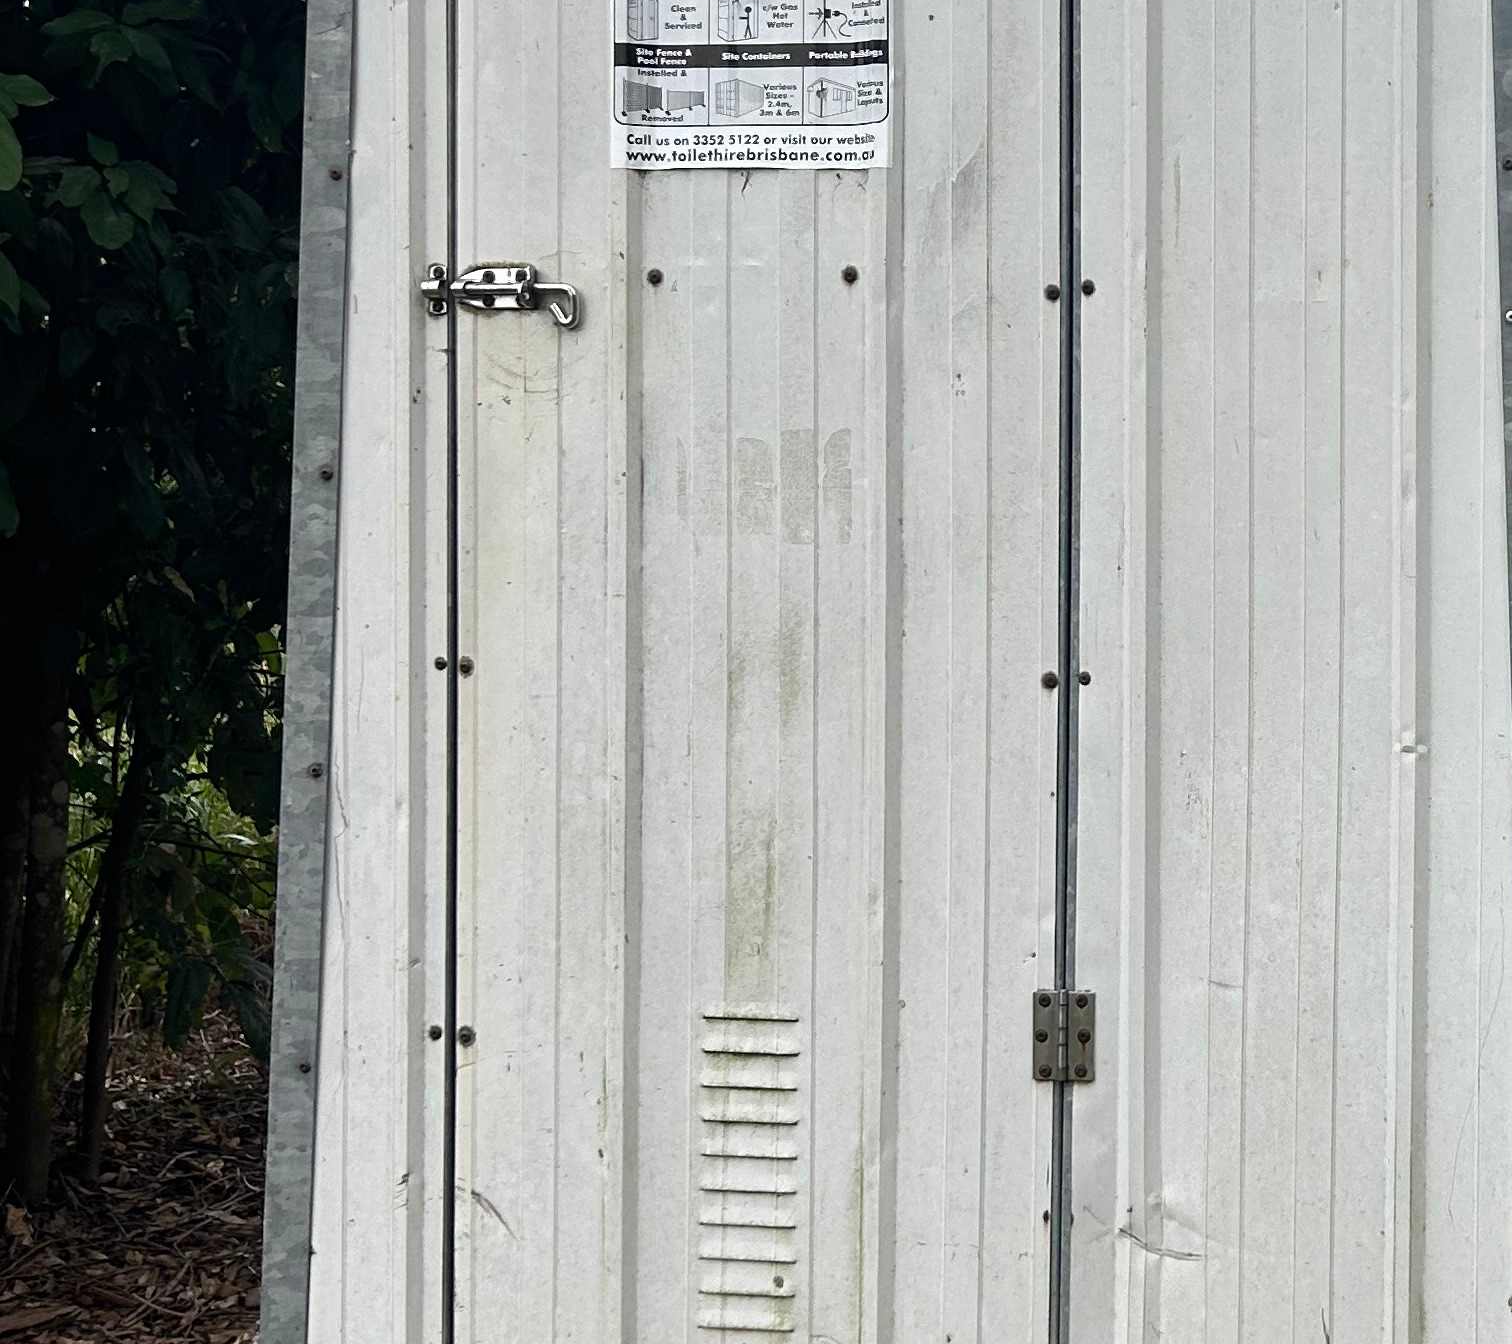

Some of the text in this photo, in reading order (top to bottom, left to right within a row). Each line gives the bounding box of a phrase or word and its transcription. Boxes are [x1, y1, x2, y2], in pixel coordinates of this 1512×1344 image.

[671, 4, 696, 13] Clean
[780, 3, 799, 11] Gas
[680, 13, 687, 21] &
[772, 12, 788, 20] Hot
[664, 21, 703, 30] Serviced
[767, 21, 794, 29] Water
[636, 48, 653, 57] Site
[656, 48, 682, 57] Fence
[721, 52, 791, 61] Site Containers
[808, 50, 849, 59] Portable
[637, 57, 687, 66] Pool Fence
[638, 69, 678, 77] Installed
[763, 83, 798, 91] Various
[765, 91, 788, 99] Sizes
[641, 114, 684, 122] Removed
[626, 133, 652, 146] Call
[655, 137, 670, 146] us
[674, 137, 689, 146] on
[693, 134, 725, 146] 3352
[728, 134, 760, 145] 5122
[763, 136, 777, 145] or
[781, 133, 806, 145] visit
[811, 136, 833, 145] our
